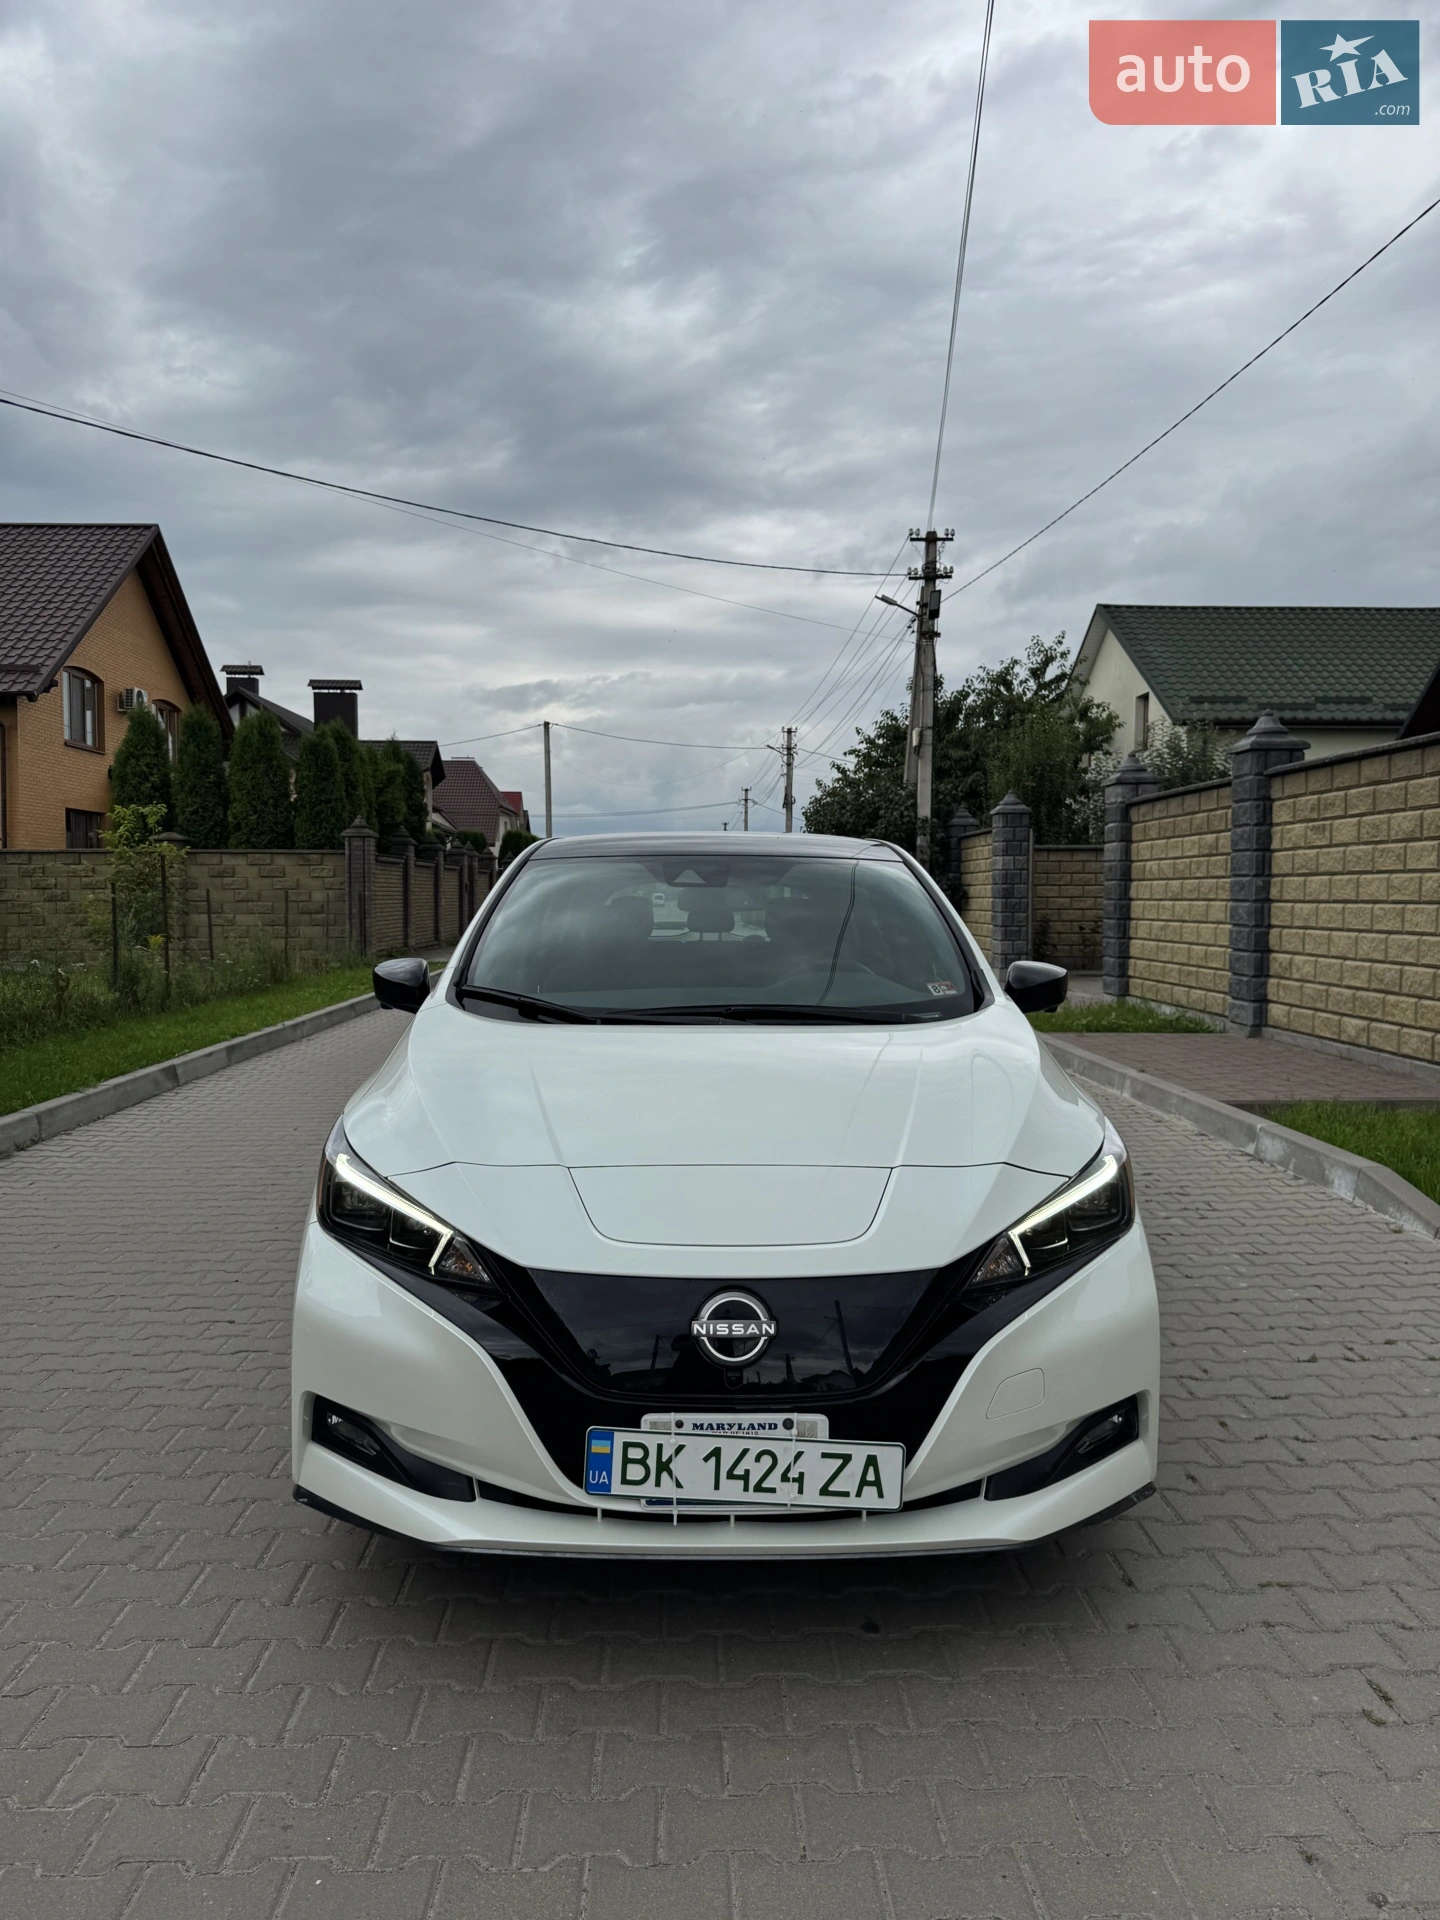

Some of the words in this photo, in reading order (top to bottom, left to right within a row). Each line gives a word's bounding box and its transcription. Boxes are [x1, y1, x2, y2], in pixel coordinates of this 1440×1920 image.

[693, 1323, 775, 1335] NISSAN
[691, 1422, 779, 1431] MARYLAND
[620, 1441, 687, 1489] BK
[702, 1446, 805, 1496] 1424
[819, 1452, 884, 1499] ZA
[589, 1470, 609, 1485] UA
